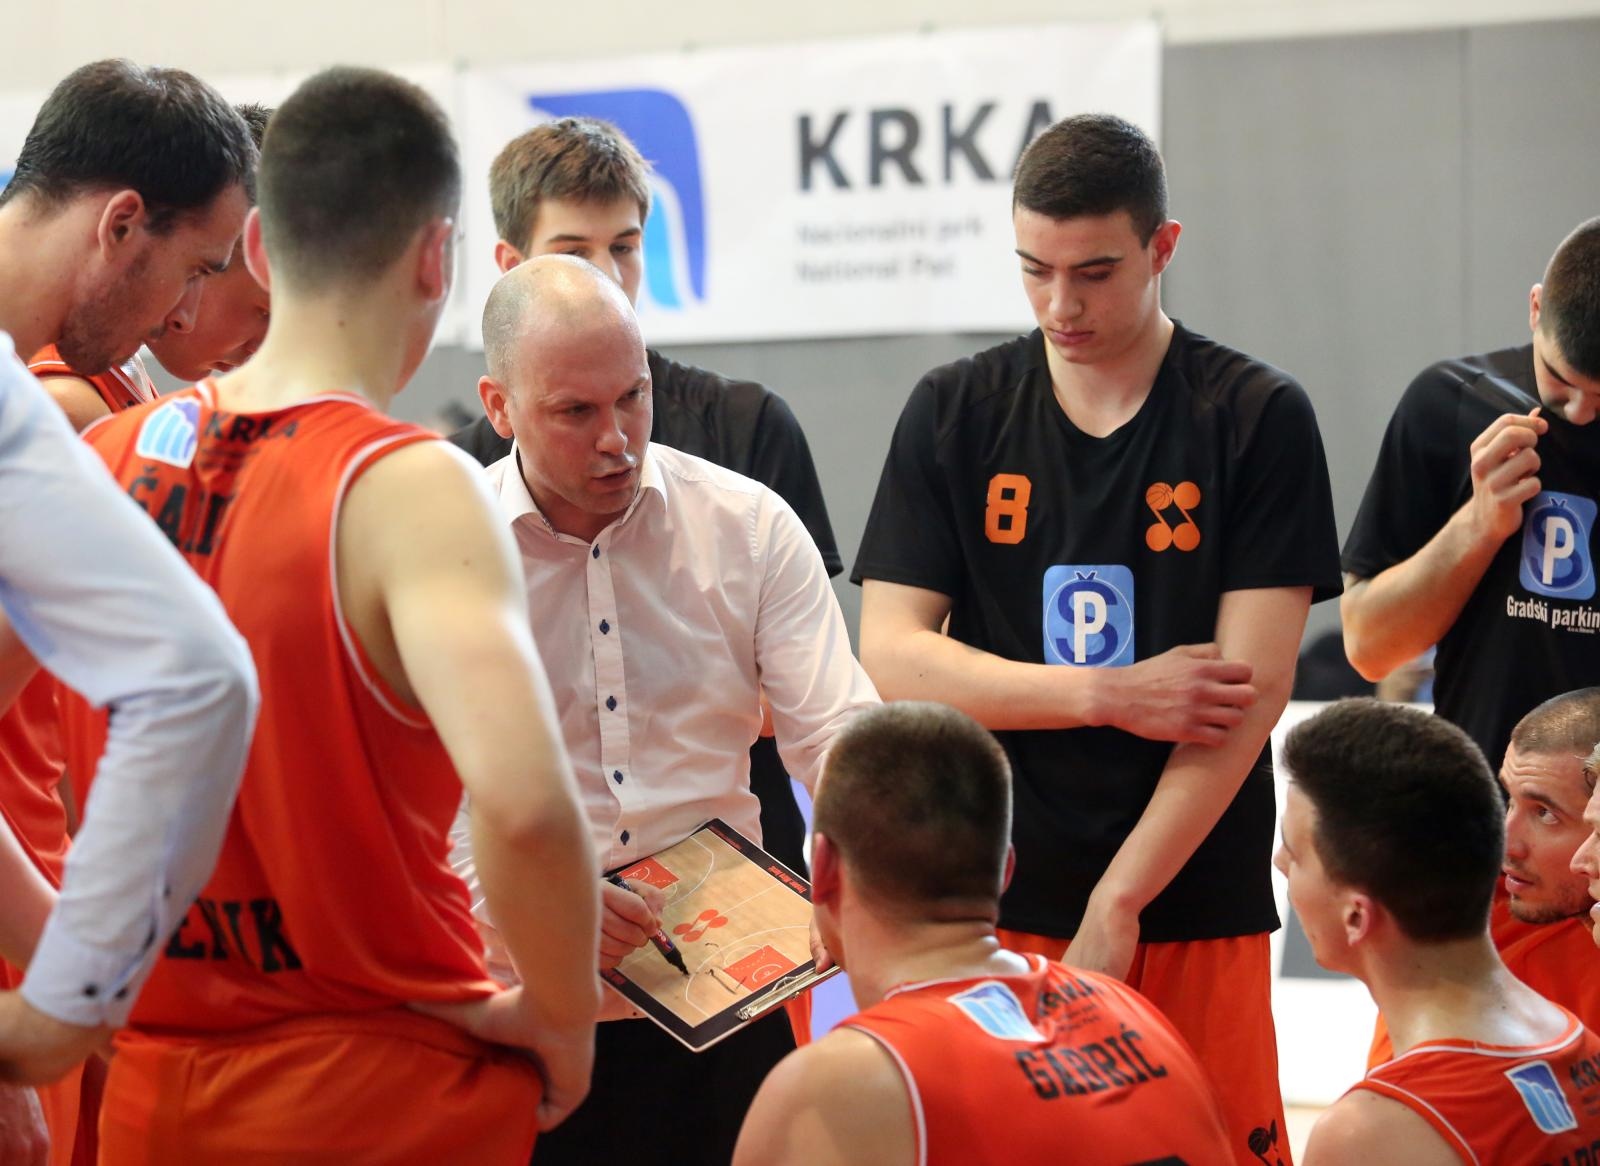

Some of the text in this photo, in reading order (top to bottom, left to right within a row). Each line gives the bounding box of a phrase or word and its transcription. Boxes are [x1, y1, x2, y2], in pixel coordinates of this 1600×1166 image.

[985, 473, 1032, 545] 8
[1506, 595, 1548, 622] Gradski
[1013, 1021, 1168, 1101] GABRIĆ
